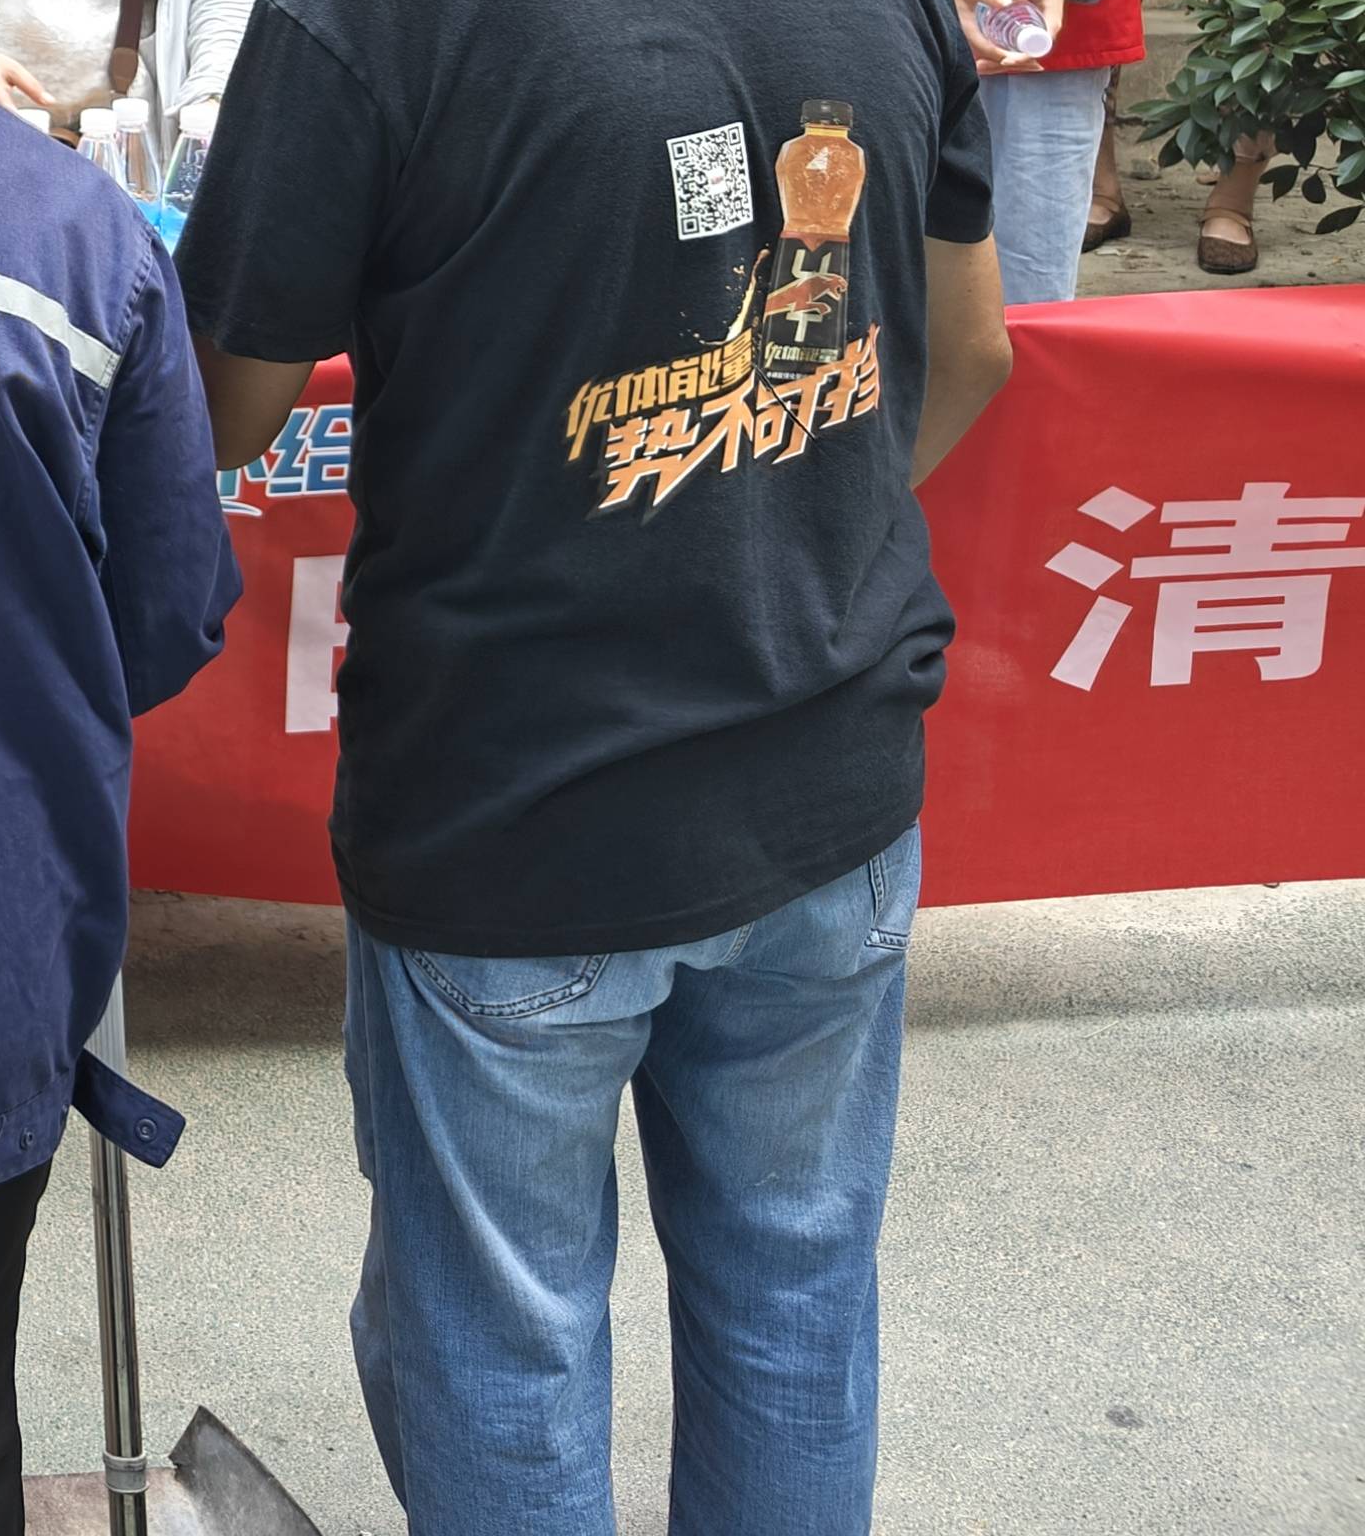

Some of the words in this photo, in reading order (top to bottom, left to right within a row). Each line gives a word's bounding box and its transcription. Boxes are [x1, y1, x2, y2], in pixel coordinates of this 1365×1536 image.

[565, 326, 753, 462] 优体能量
[1043, 480, 1365, 692] 清
